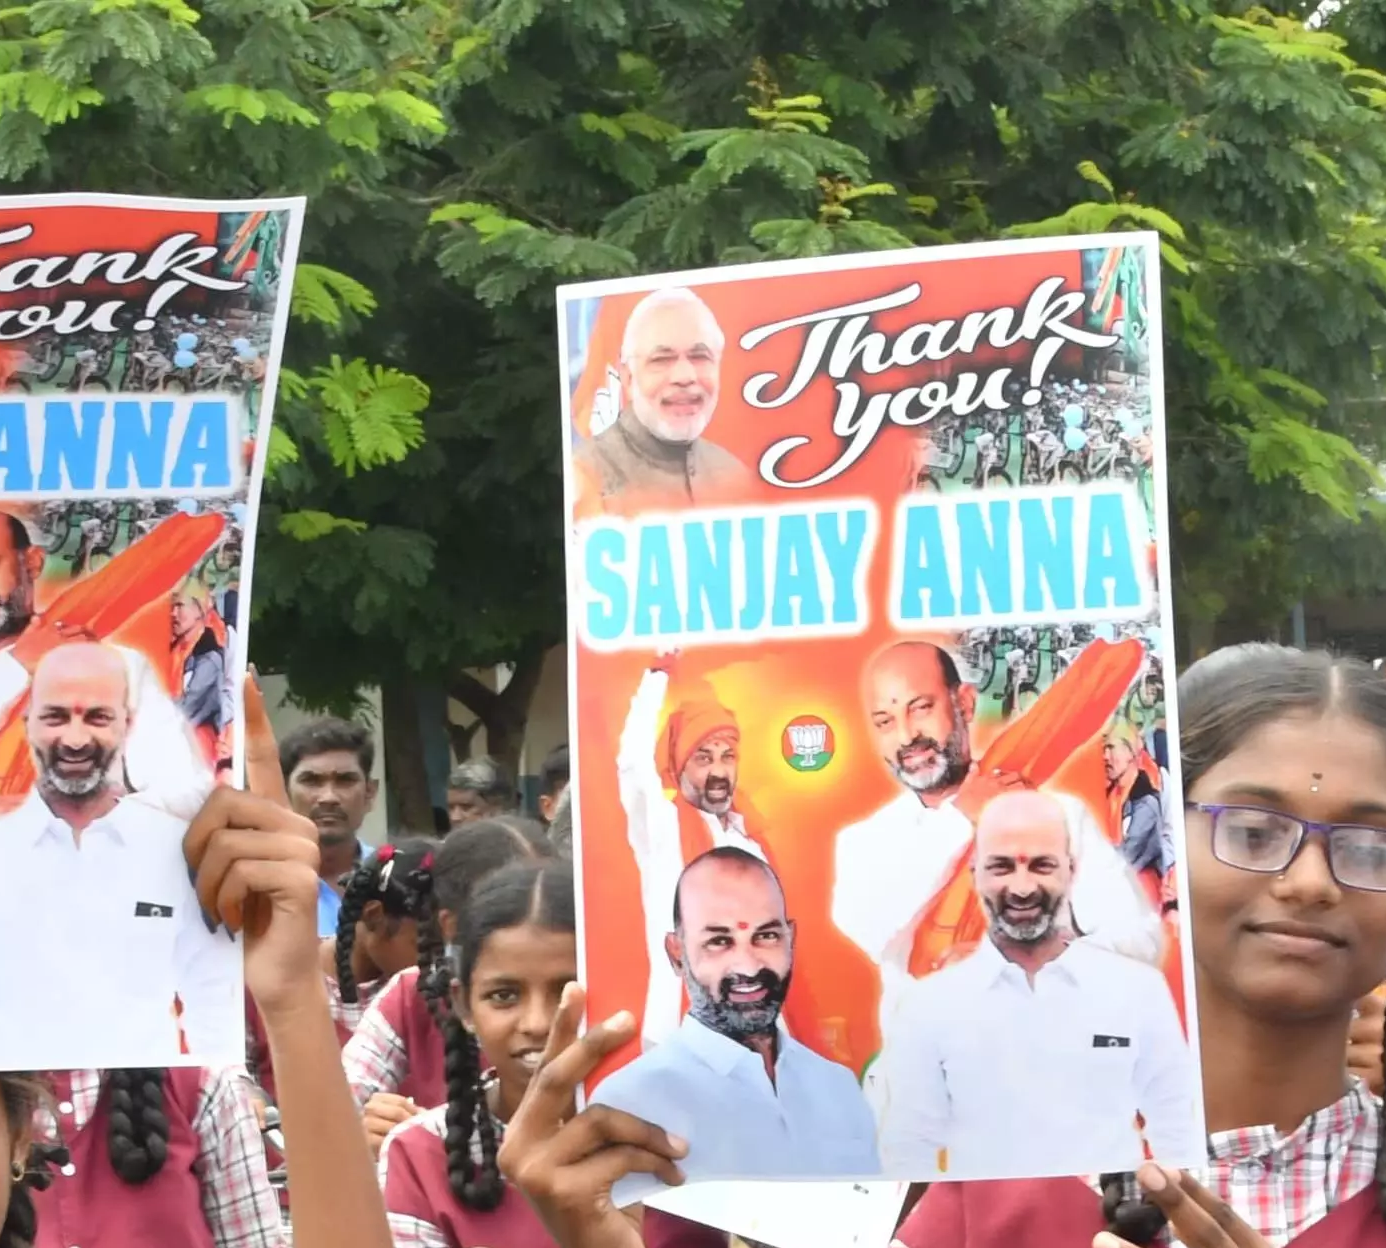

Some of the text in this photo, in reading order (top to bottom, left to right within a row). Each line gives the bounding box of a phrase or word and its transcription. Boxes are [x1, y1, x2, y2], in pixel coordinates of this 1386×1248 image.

[740, 276, 1119, 408] Thank
[759, 337, 1065, 489] you!
[584, 494, 1141, 640] SANJAY ANNA
